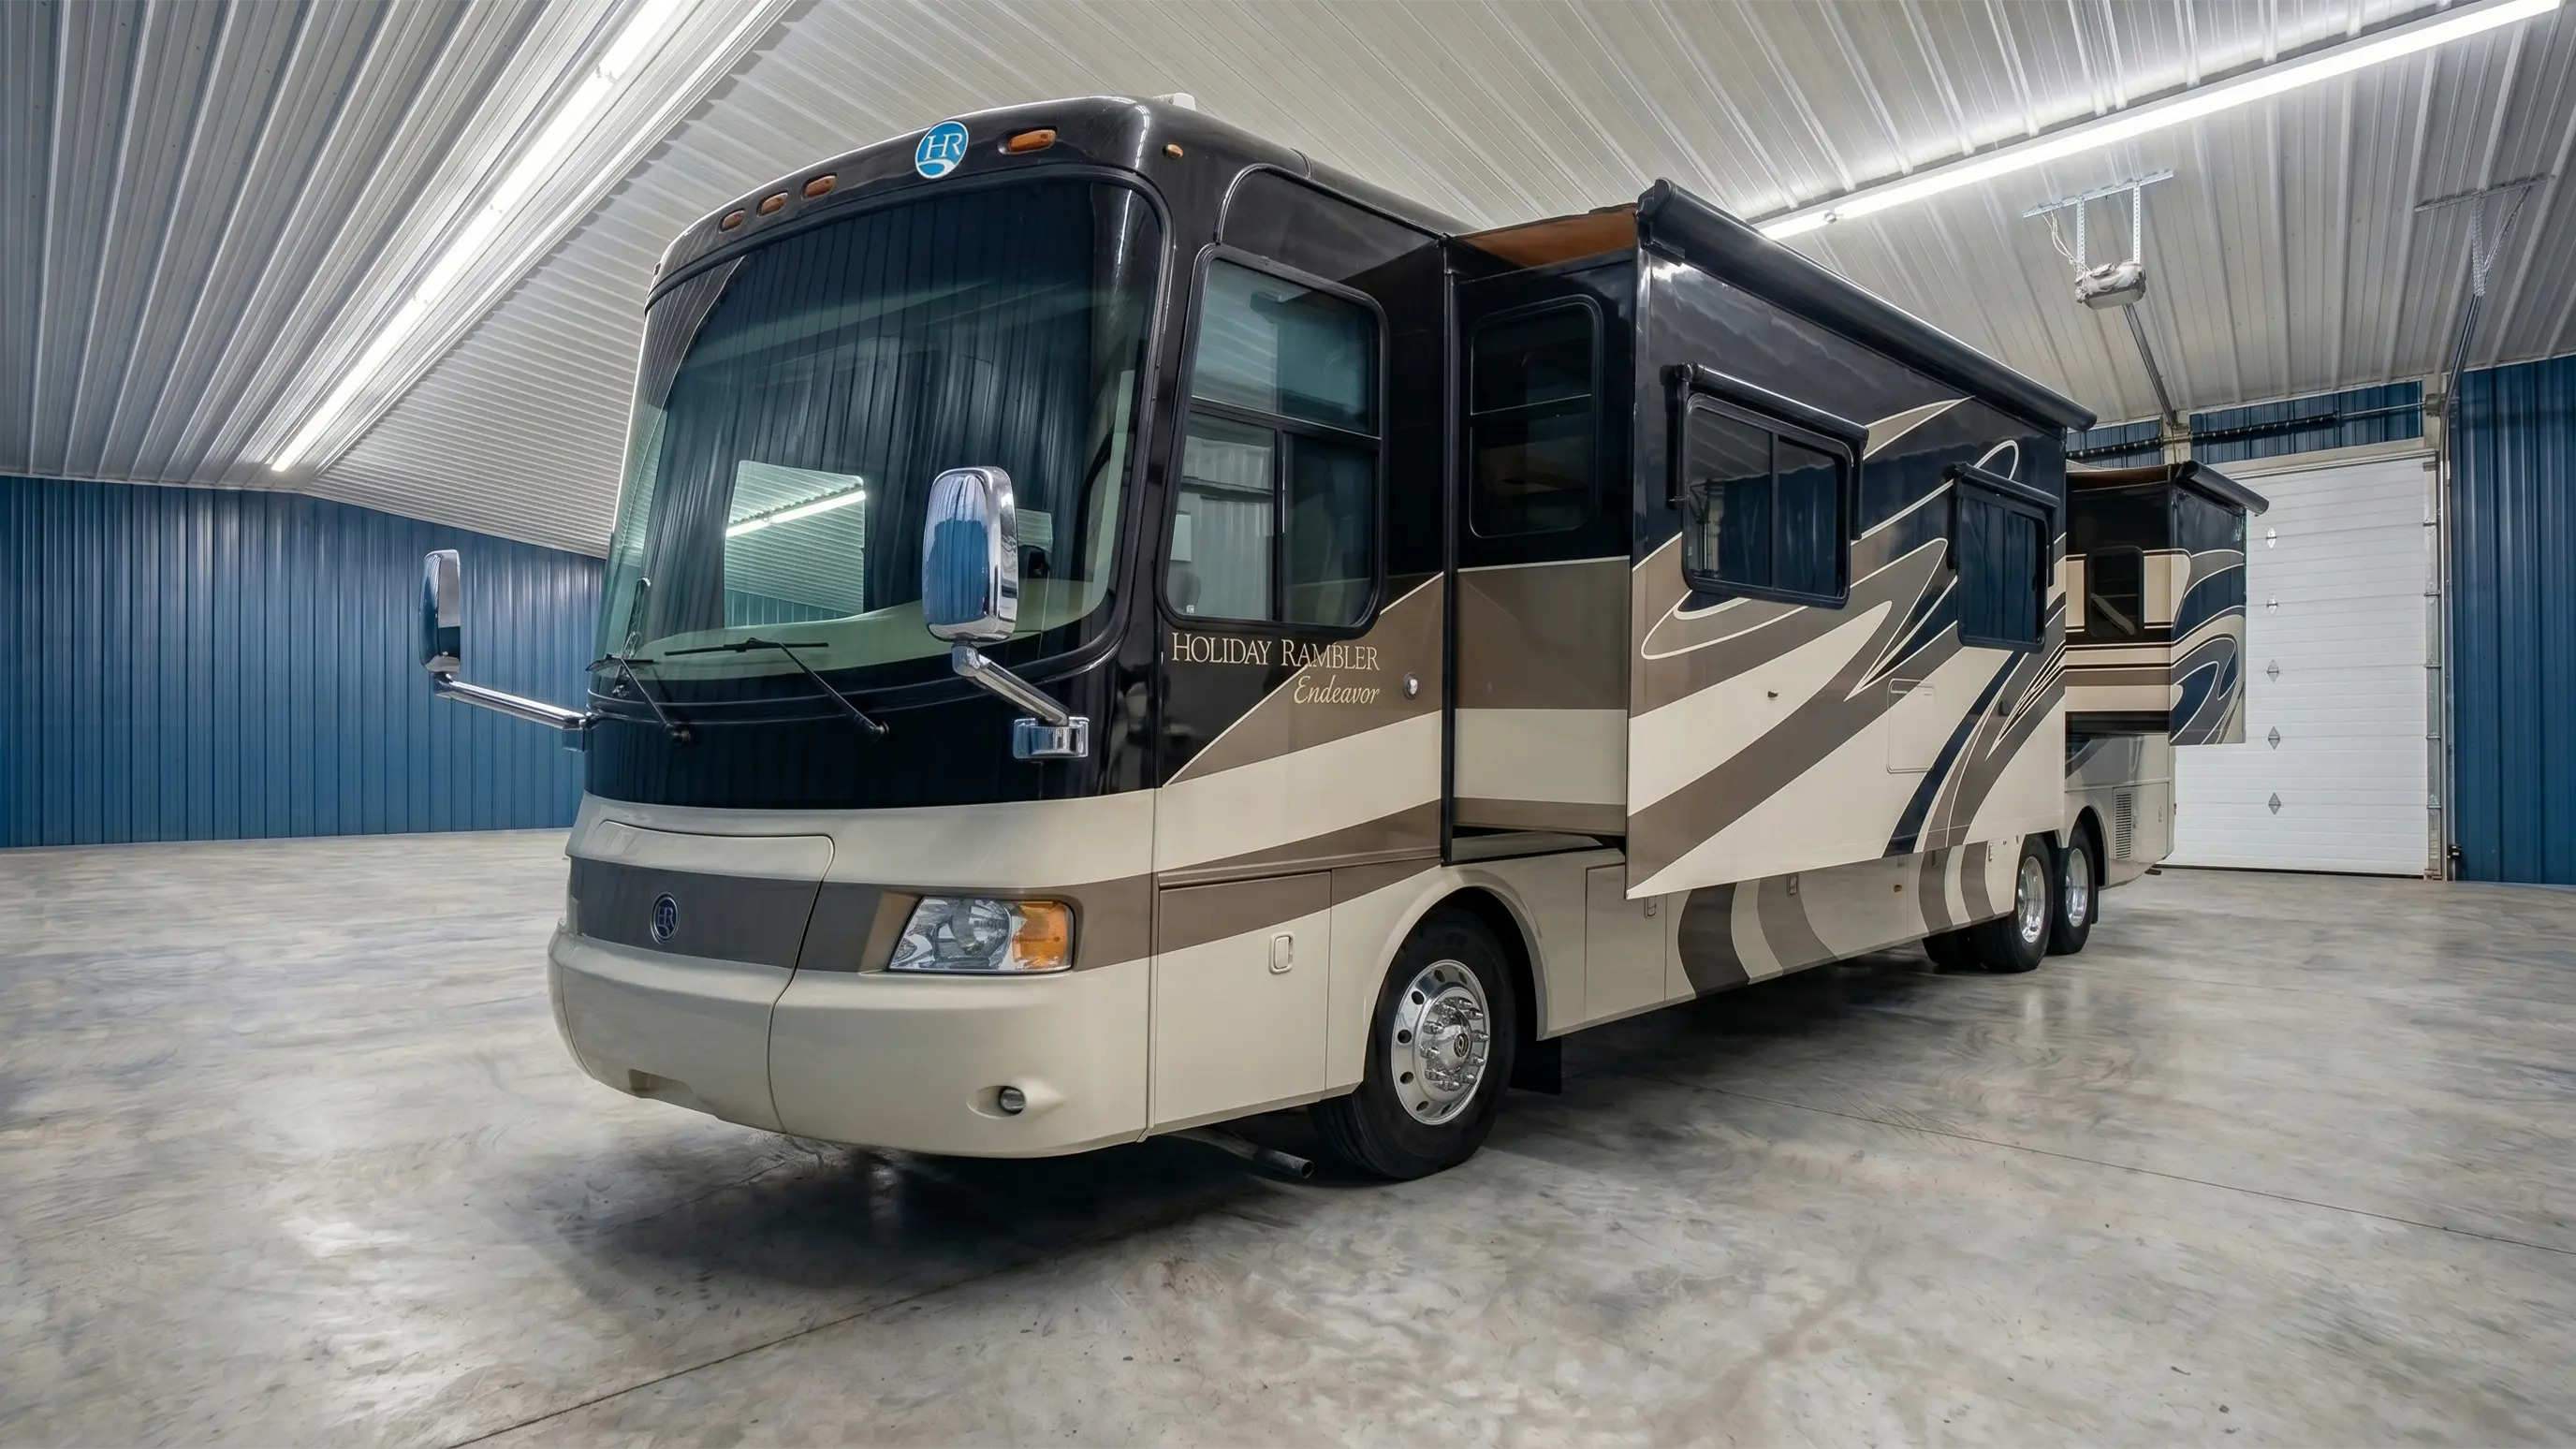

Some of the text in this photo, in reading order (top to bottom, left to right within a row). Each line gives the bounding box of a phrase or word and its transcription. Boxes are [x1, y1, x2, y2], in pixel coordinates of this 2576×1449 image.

[924, 132, 963, 160] HR
[1171, 632, 1380, 670] HOLIDAY RAMBLER
[1294, 675, 1380, 704] Endeavor
[657, 906, 675, 928] HR
